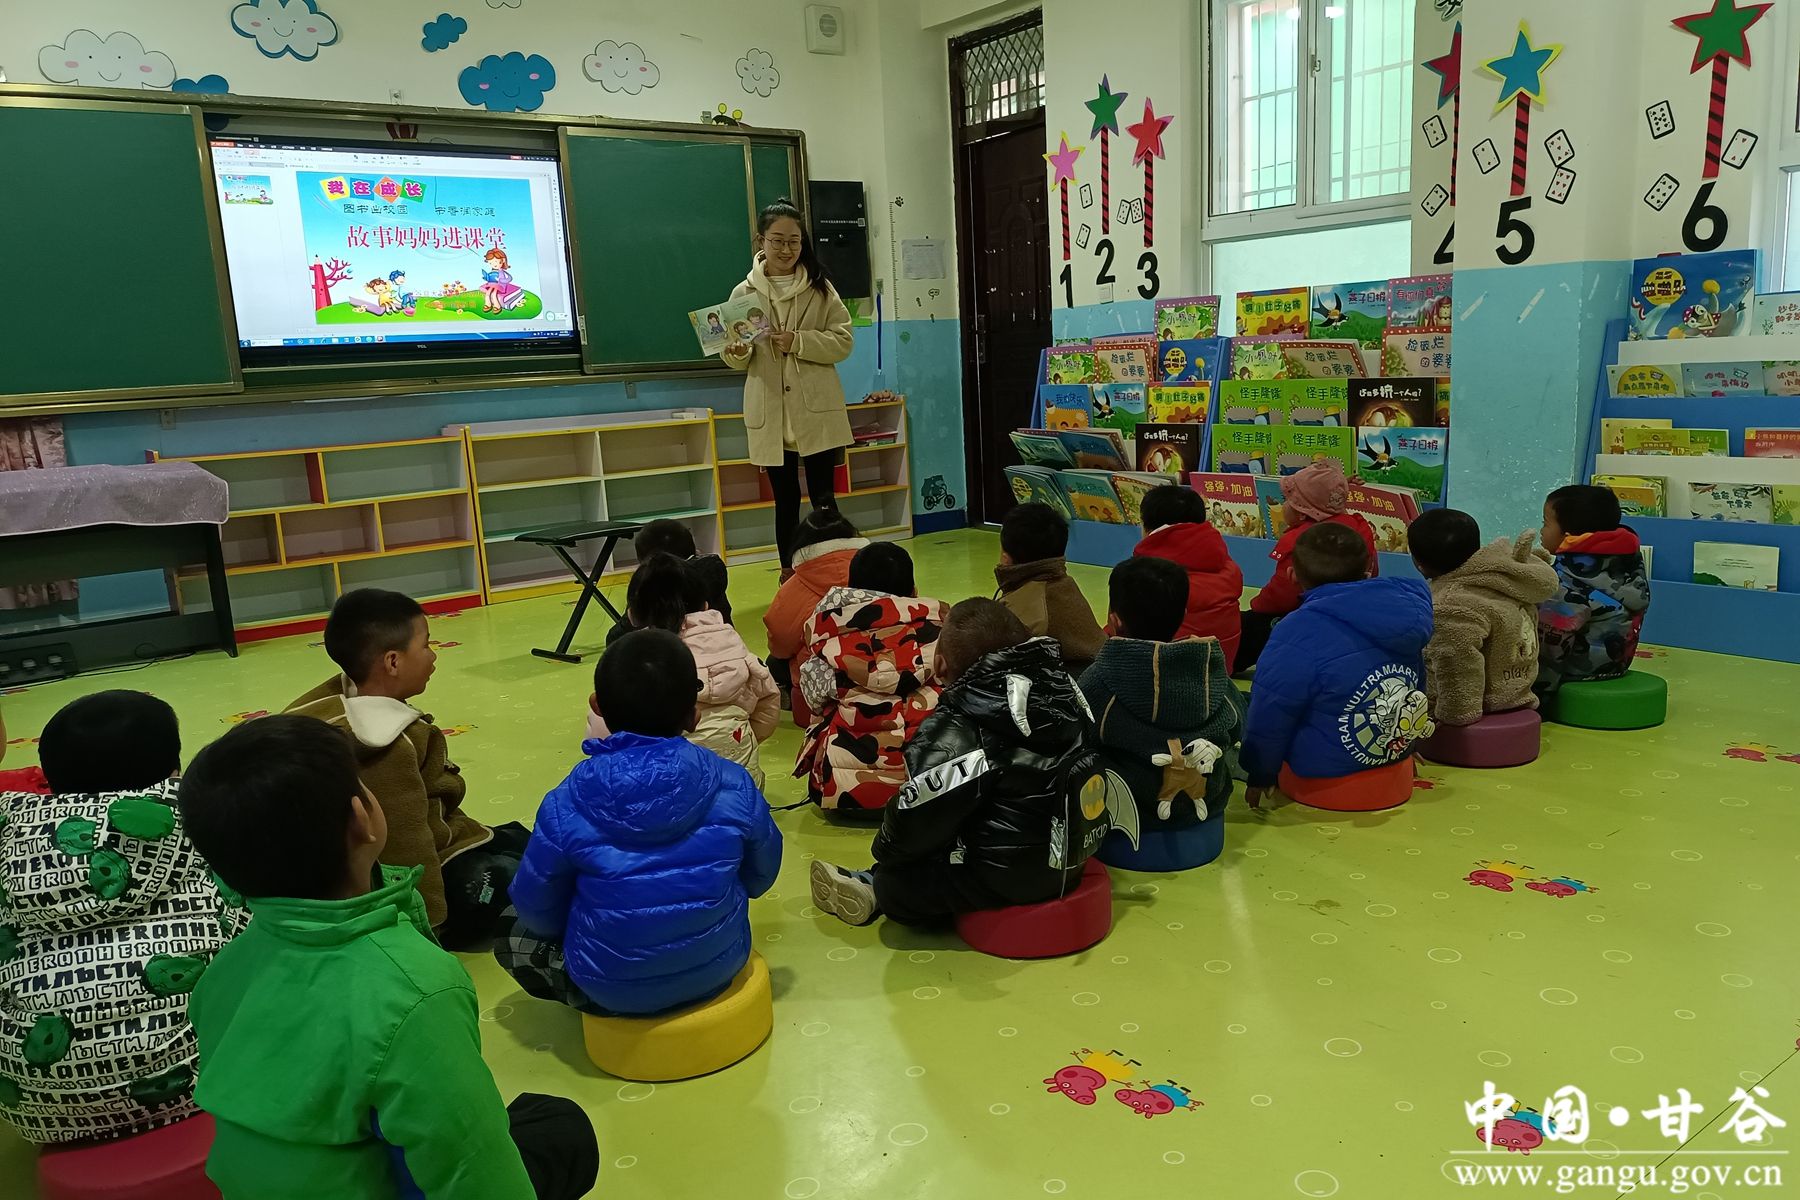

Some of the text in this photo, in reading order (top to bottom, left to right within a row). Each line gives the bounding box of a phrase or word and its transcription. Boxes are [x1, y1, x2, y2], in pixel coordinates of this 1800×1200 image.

[327, 180, 423, 197] 我在成长
[1495, 196, 1536, 265] 5
[1681, 180, 1729, 252] 6
[347, 225, 507, 250] 故事妈妈进课堂
[1094, 238, 1116, 285] 2
[1136, 252, 1160, 300] 3
[1060, 264, 1073, 308] 1
[1239, 386, 1282, 400] 怪手隆隆
[1293, 433, 1341, 448] 怪手隆隆
[1397, 436, 1439, 451] 燕子日报
